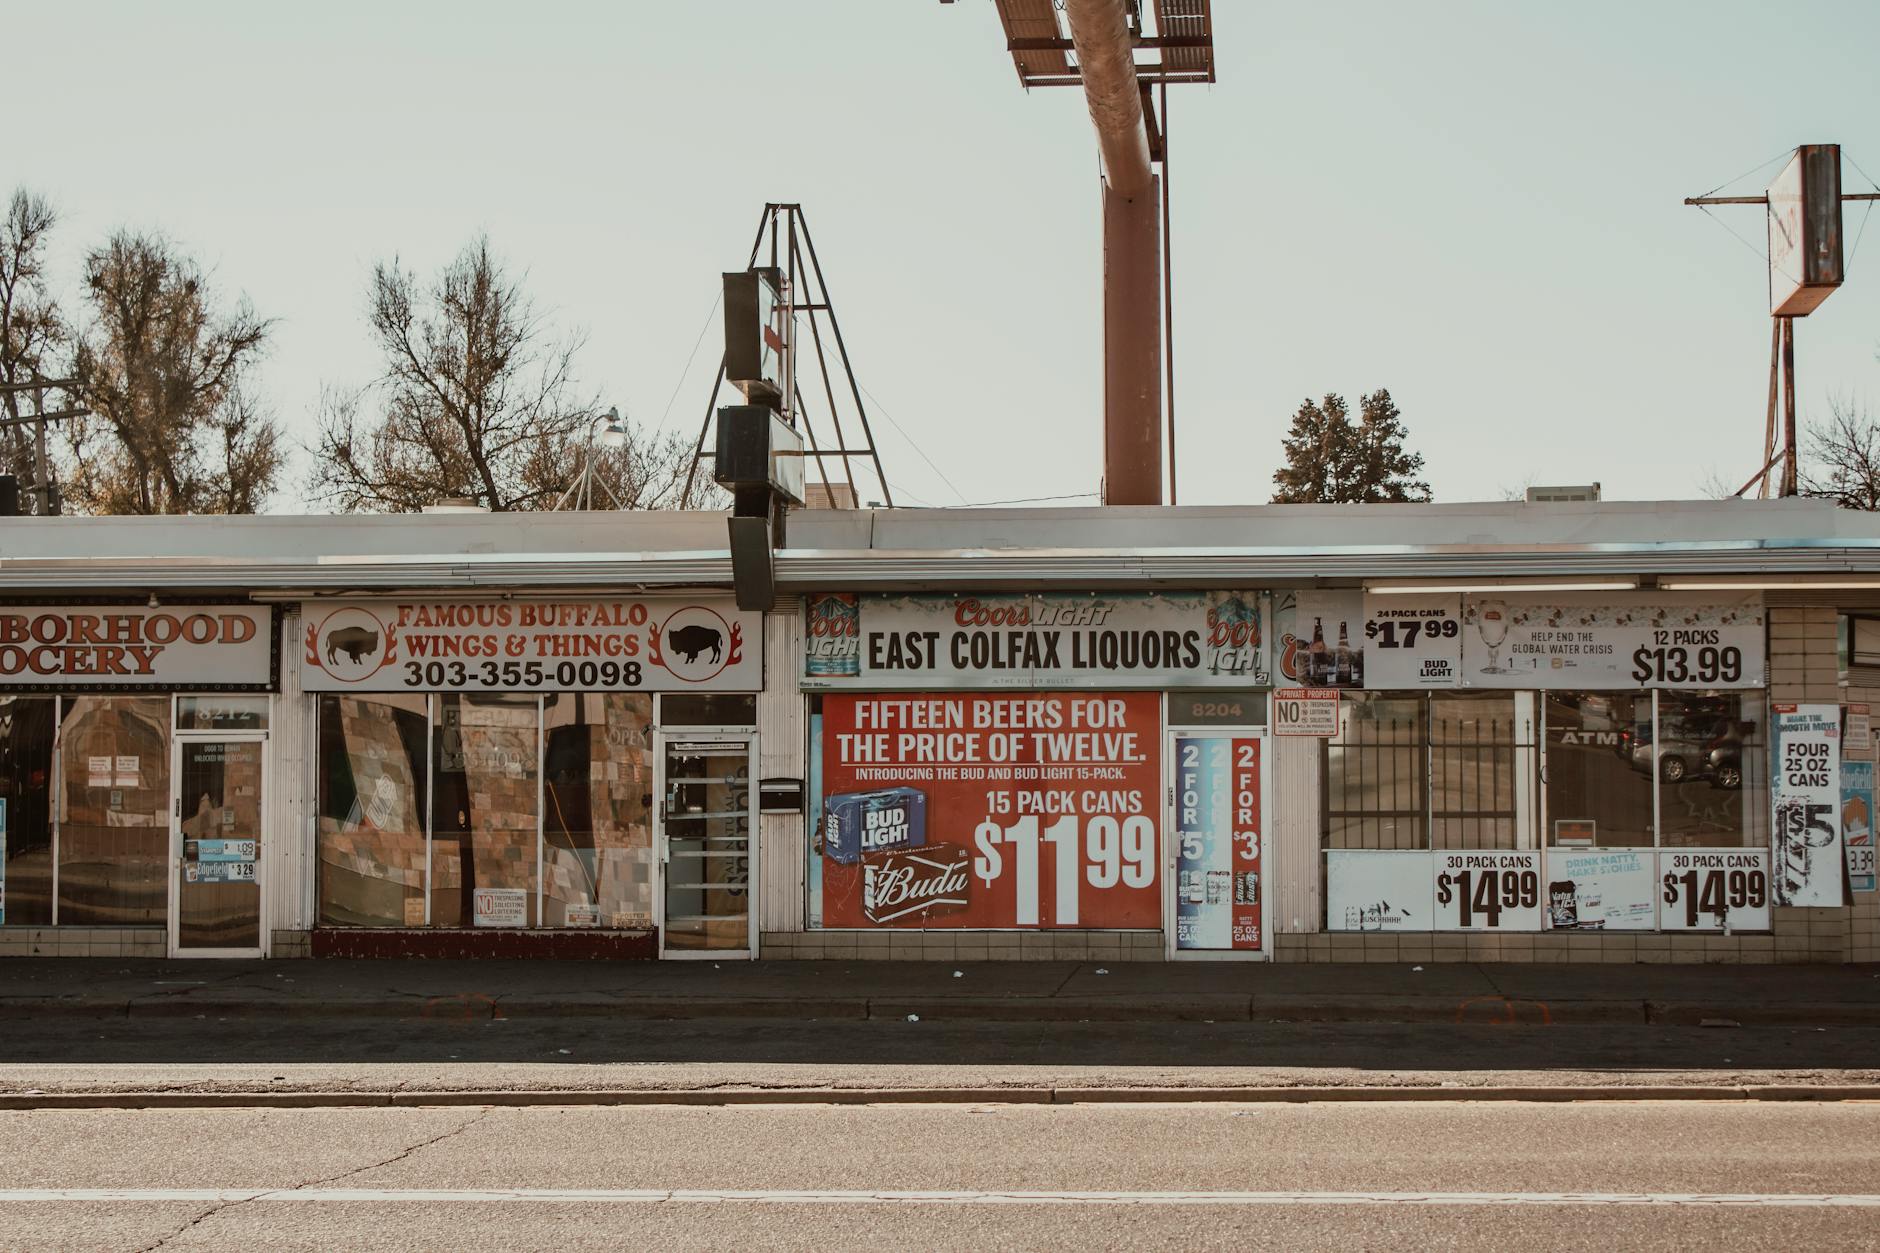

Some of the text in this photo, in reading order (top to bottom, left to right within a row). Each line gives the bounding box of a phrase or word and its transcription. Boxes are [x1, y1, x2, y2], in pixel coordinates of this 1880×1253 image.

[397, 603, 648, 627] FAMOUS BUFFALO
[953, 599, 1113, 627] Coors LIGHT
[1419, 609, 1446, 617] CANS
[0, 614, 257, 644] BORHOOD
[1531, 631, 1594, 642] HELP END THE
[1653, 629, 1719, 645] 12 PACKS
[404, 633, 640, 657] WINGS & THINGS
[869, 630, 1201, 670] EAST COLFAX LIQUORS
[1511, 644, 1613, 655] GLOBAL WATER CRISIS
[1207, 649, 1261, 671] IGHT
[1424, 660, 1448, 668] BUD
[1631, 643, 1742, 686] $13.99
[403, 660, 643, 687] 303-355-0098
[1420, 668, 1453, 677] LIGHT
[1282, 690, 1337, 698] PRIVATE PROPERTY
[199, 706, 250, 720] 8212
[855, 700, 1126, 729] FIFTEEN BEERS FOR
[1192, 703, 1242, 717] 8204
[1278, 702, 1299, 723] NO
[1808, 714, 1823, 722] THE
[1561, 731, 1618, 745] ATM
[836, 732, 1146, 762] THE PRICE OF TWELVE.
[1787, 743, 1830, 757] FOUR
[1182, 744, 1200, 768] 2
[1237, 744, 1255, 768] 2
[1785, 758, 1832, 772] 25 OZ.
[855, 767, 1126, 780] INTRODUCING THE BUD AND BUD LIGHT 15-PACK.
[1788, 773, 1829, 787] CANS
[1840, 767, 1873, 791] dgefield
[986, 790, 1143, 814] 15 PACK CANS
[866, 808, 905, 830] BUD
[861, 823, 909, 847] LIGHT
[1233, 830, 1259, 860] $3
[1447, 856, 1532, 868] 30 PACK CANS
[1566, 857, 1599, 869] DRINK
[1673, 855, 1760, 868] 30 PACK CANS
[1850, 850, 1874, 871] 3.39
[197, 862, 228, 876] Edgefield
[477, 895, 494, 914] NO
[1561, 899, 1576, 908] ICE
[1178, 925, 1188, 933] 25
[1233, 926, 1244, 934] 25
[1234, 934, 1258, 942] CANS
